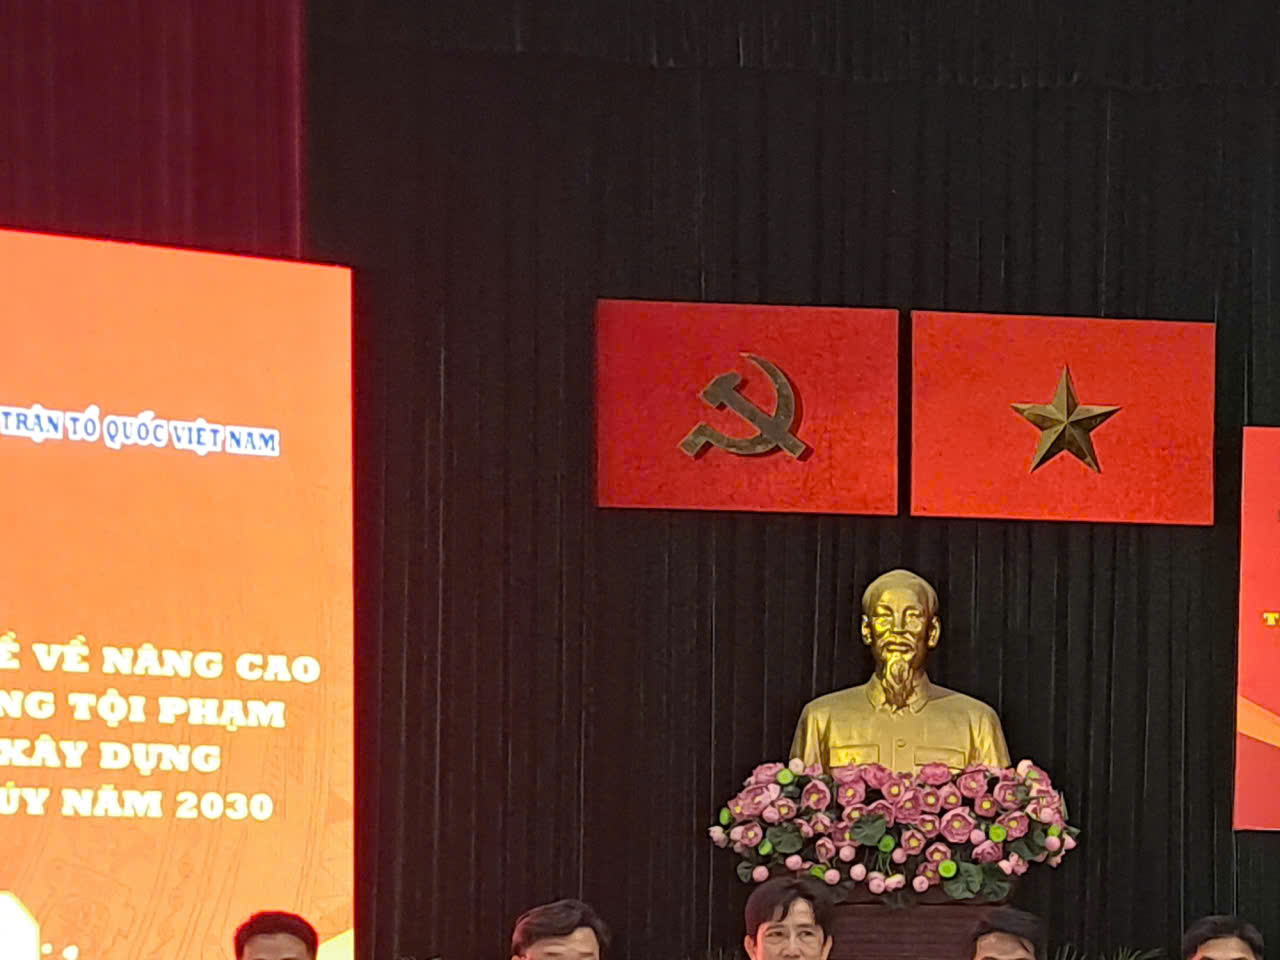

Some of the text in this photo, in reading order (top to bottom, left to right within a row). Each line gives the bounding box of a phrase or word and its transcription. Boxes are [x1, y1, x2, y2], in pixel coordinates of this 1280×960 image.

[228, 428, 278, 455] NAM
[102, 643, 223, 678] NÂNG
[235, 653, 321, 683] CAO
[67, 687, 147, 727] TỘI
[158, 696, 286, 732] PHẠM
[0, 734, 222, 776] XÂY DỰNG
[61, 783, 163, 818] NĂM
[175, 791, 274, 821] 2030
